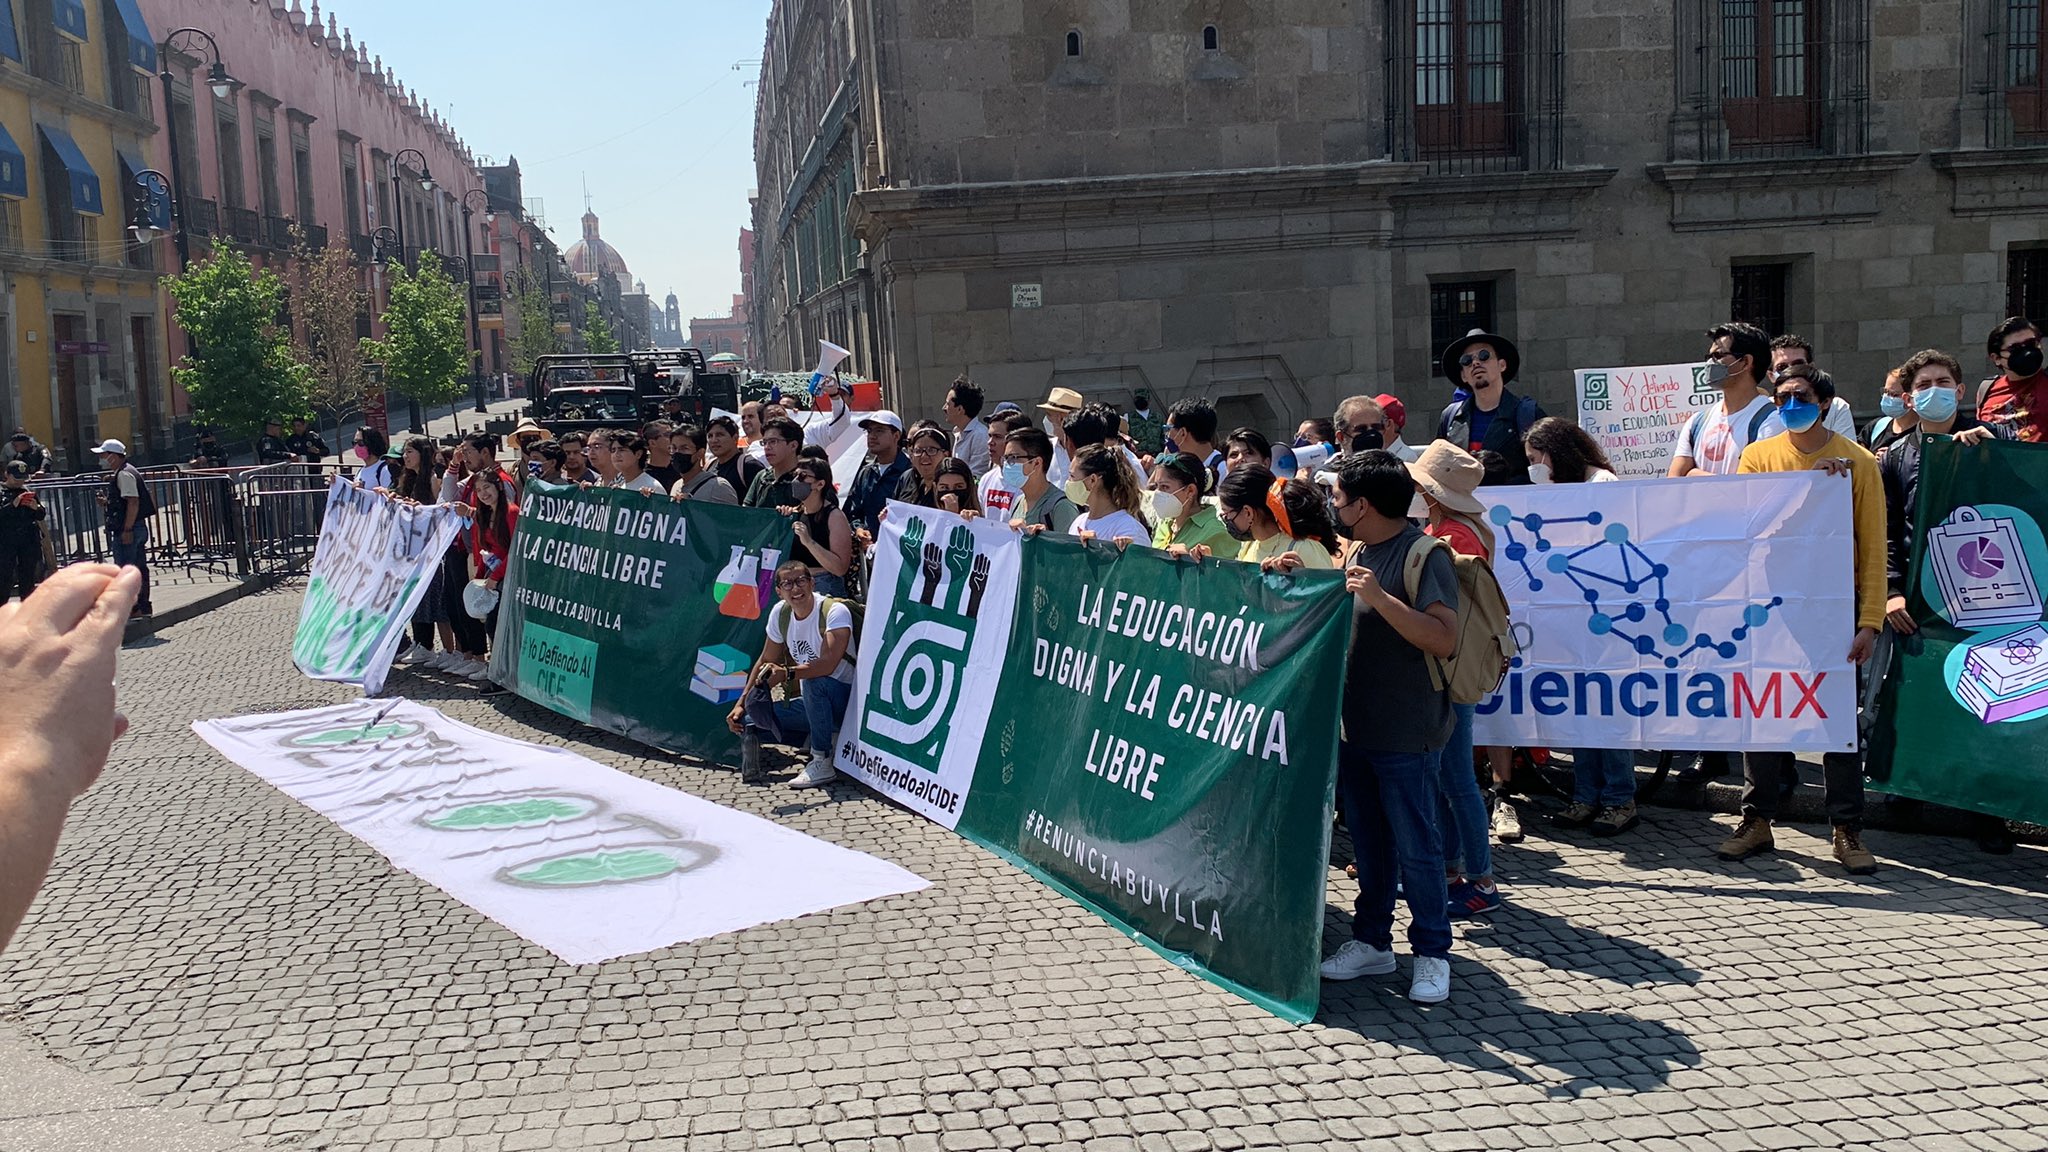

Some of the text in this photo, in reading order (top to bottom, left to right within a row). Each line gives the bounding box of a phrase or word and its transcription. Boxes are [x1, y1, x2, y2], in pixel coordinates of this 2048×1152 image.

[1582, 400, 1612, 411] CIDE
[1616, 372, 1680, 398] Yo defiendo
[1623, 394, 1677, 413] al CIDE
[1585, 417, 1601, 435] Por
[1605, 423, 1621, 435] una
[1668, 411, 1697, 425] LIBR
[1649, 430, 1681, 444] LABOR
[519, 493, 688, 546] LA EDUCACIÓN DIGNA
[516, 531, 668, 589] Y LA CIENCIA LIBRE
[515, 587, 622, 631] #RENUNCIABUYLLA
[1077, 584, 1265, 671] LA EDUCACIÓN
[538, 641, 579, 675] Defiendo
[579, 655, 591, 679] Al
[1032, 637, 1289, 766] DIGNA Y LA CIENCIA
[1084, 729, 1166, 801] LIBRE
[1025, 809, 1224, 942] #RENUNCIABUYLLA
